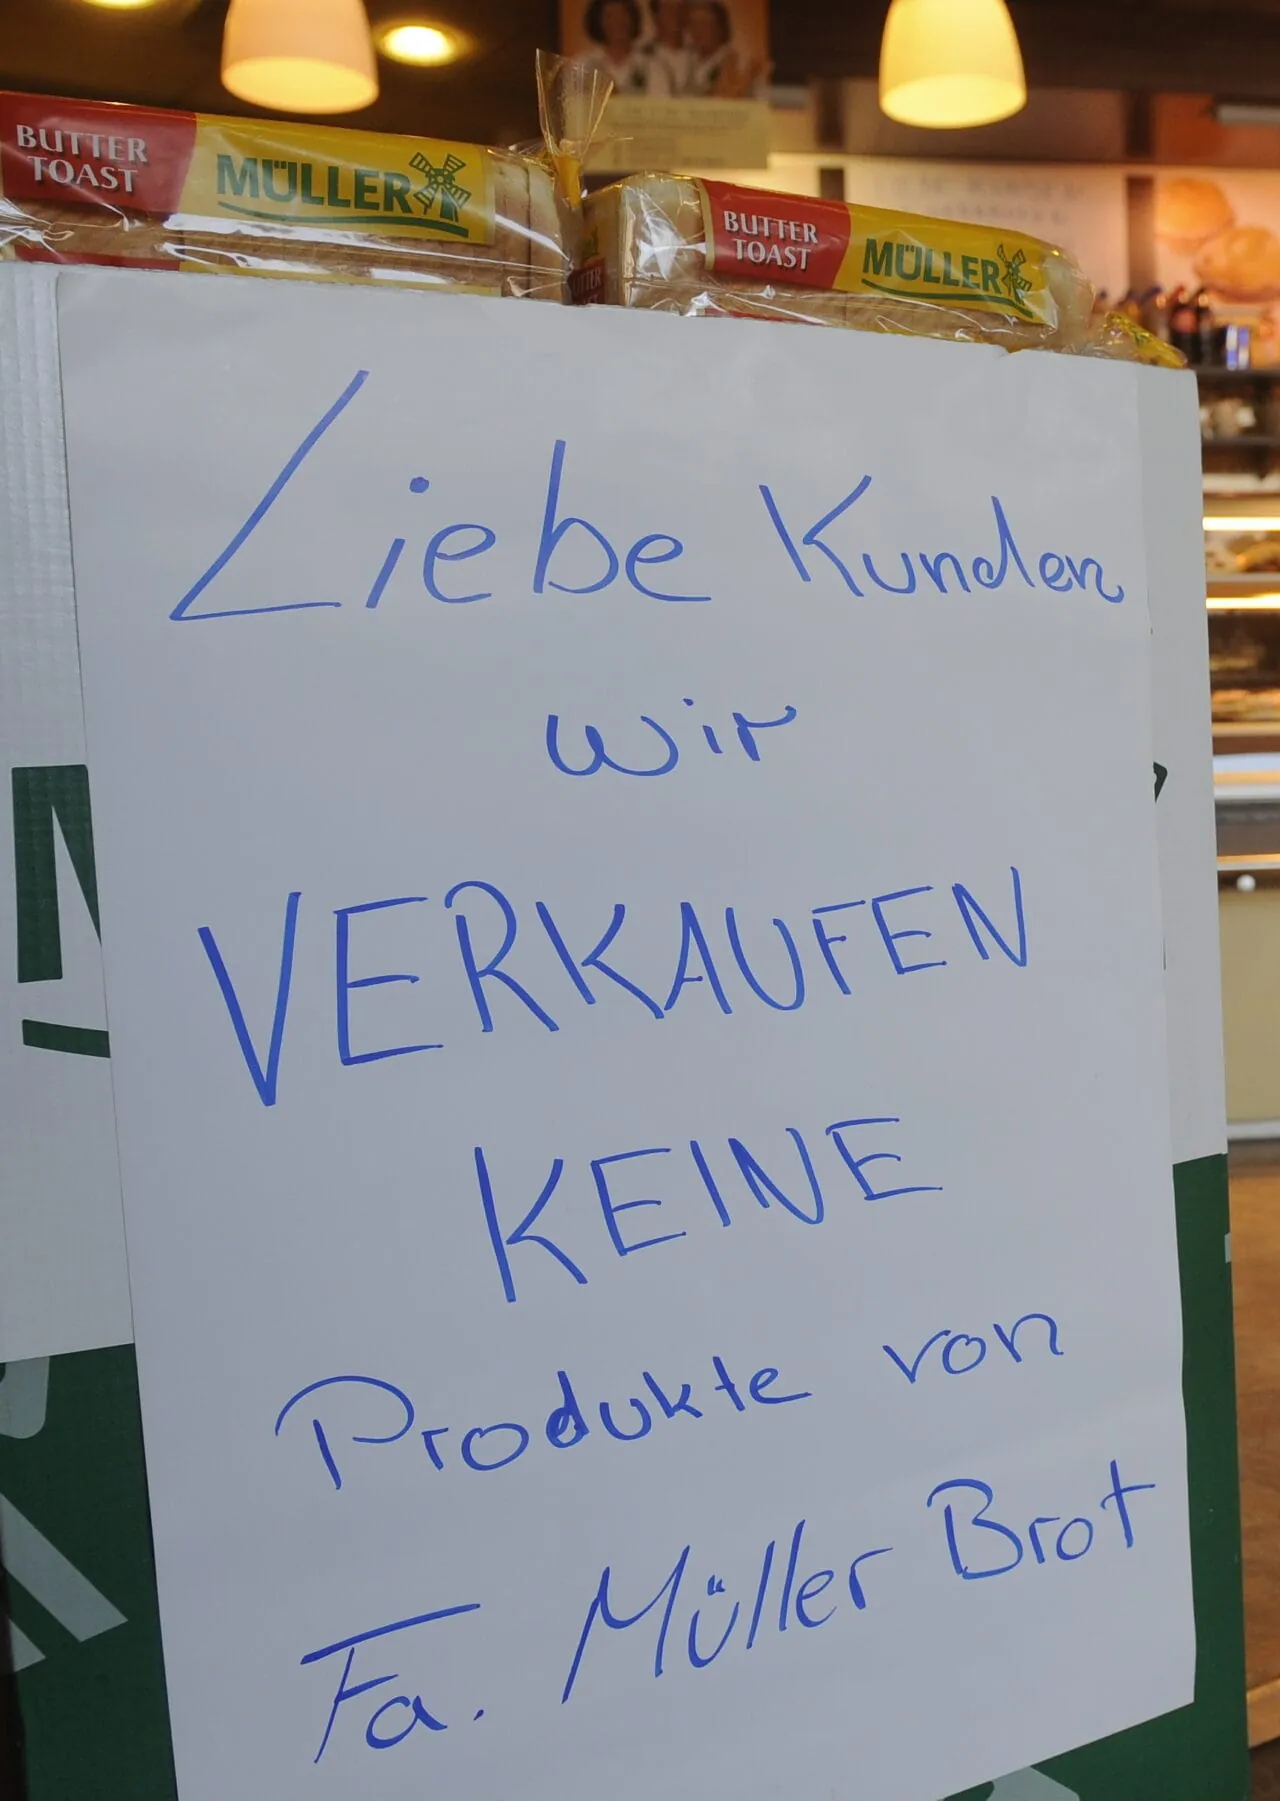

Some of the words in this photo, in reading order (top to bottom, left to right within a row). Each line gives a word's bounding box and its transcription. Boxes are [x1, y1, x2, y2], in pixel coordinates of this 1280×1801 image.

[16, 124, 148, 163] BUTTER
[27, 155, 138, 193] TOAST
[216, 153, 413, 214] MÜLLER
[723, 210, 818, 244] BUTTER
[732, 238, 811, 271] TOAST
[862, 238, 1002, 294] MÜLLER
[169, 370, 713, 622] Liebe
[760, 475, 1126, 605] Kunden
[545, 698, 799, 777] wir
[197, 867, 1030, 1108] VERKAUFEN
[474, 1116, 944, 1305] KEINE
[274, 1354, 813, 1492] Produkte
[882, 1312, 1065, 1385] von
[300, 1602, 486, 1762] Fa.
[561, 1519, 893, 1704] Müller
[925, 1459, 1156, 1582] Brot
